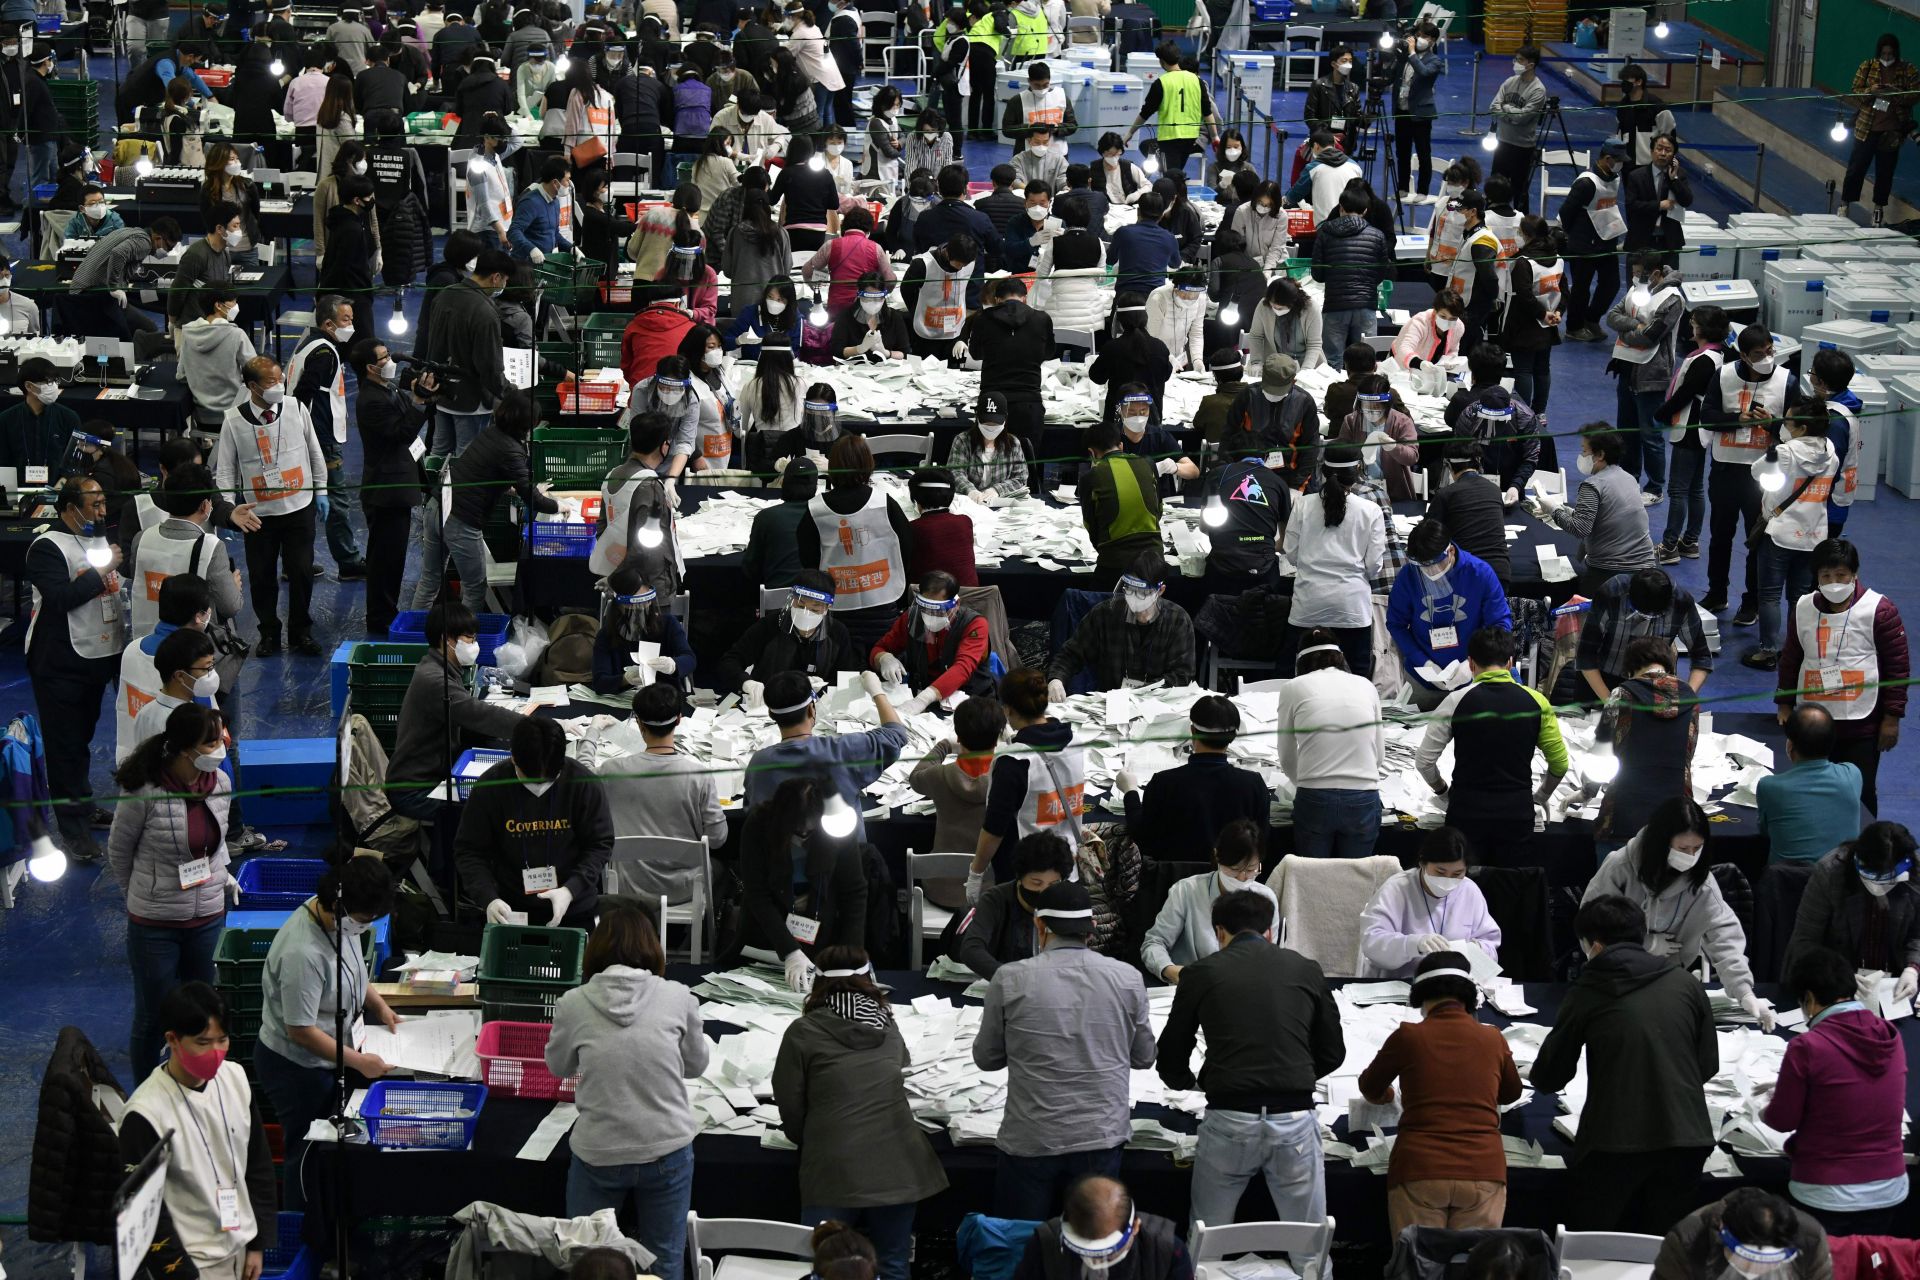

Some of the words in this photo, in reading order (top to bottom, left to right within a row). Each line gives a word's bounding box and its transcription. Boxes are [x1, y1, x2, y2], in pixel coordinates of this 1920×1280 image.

[1179, 88, 1185, 112] 1
[986, 398, 997, 412] LA
[835, 570, 885, 591] 개표참관
